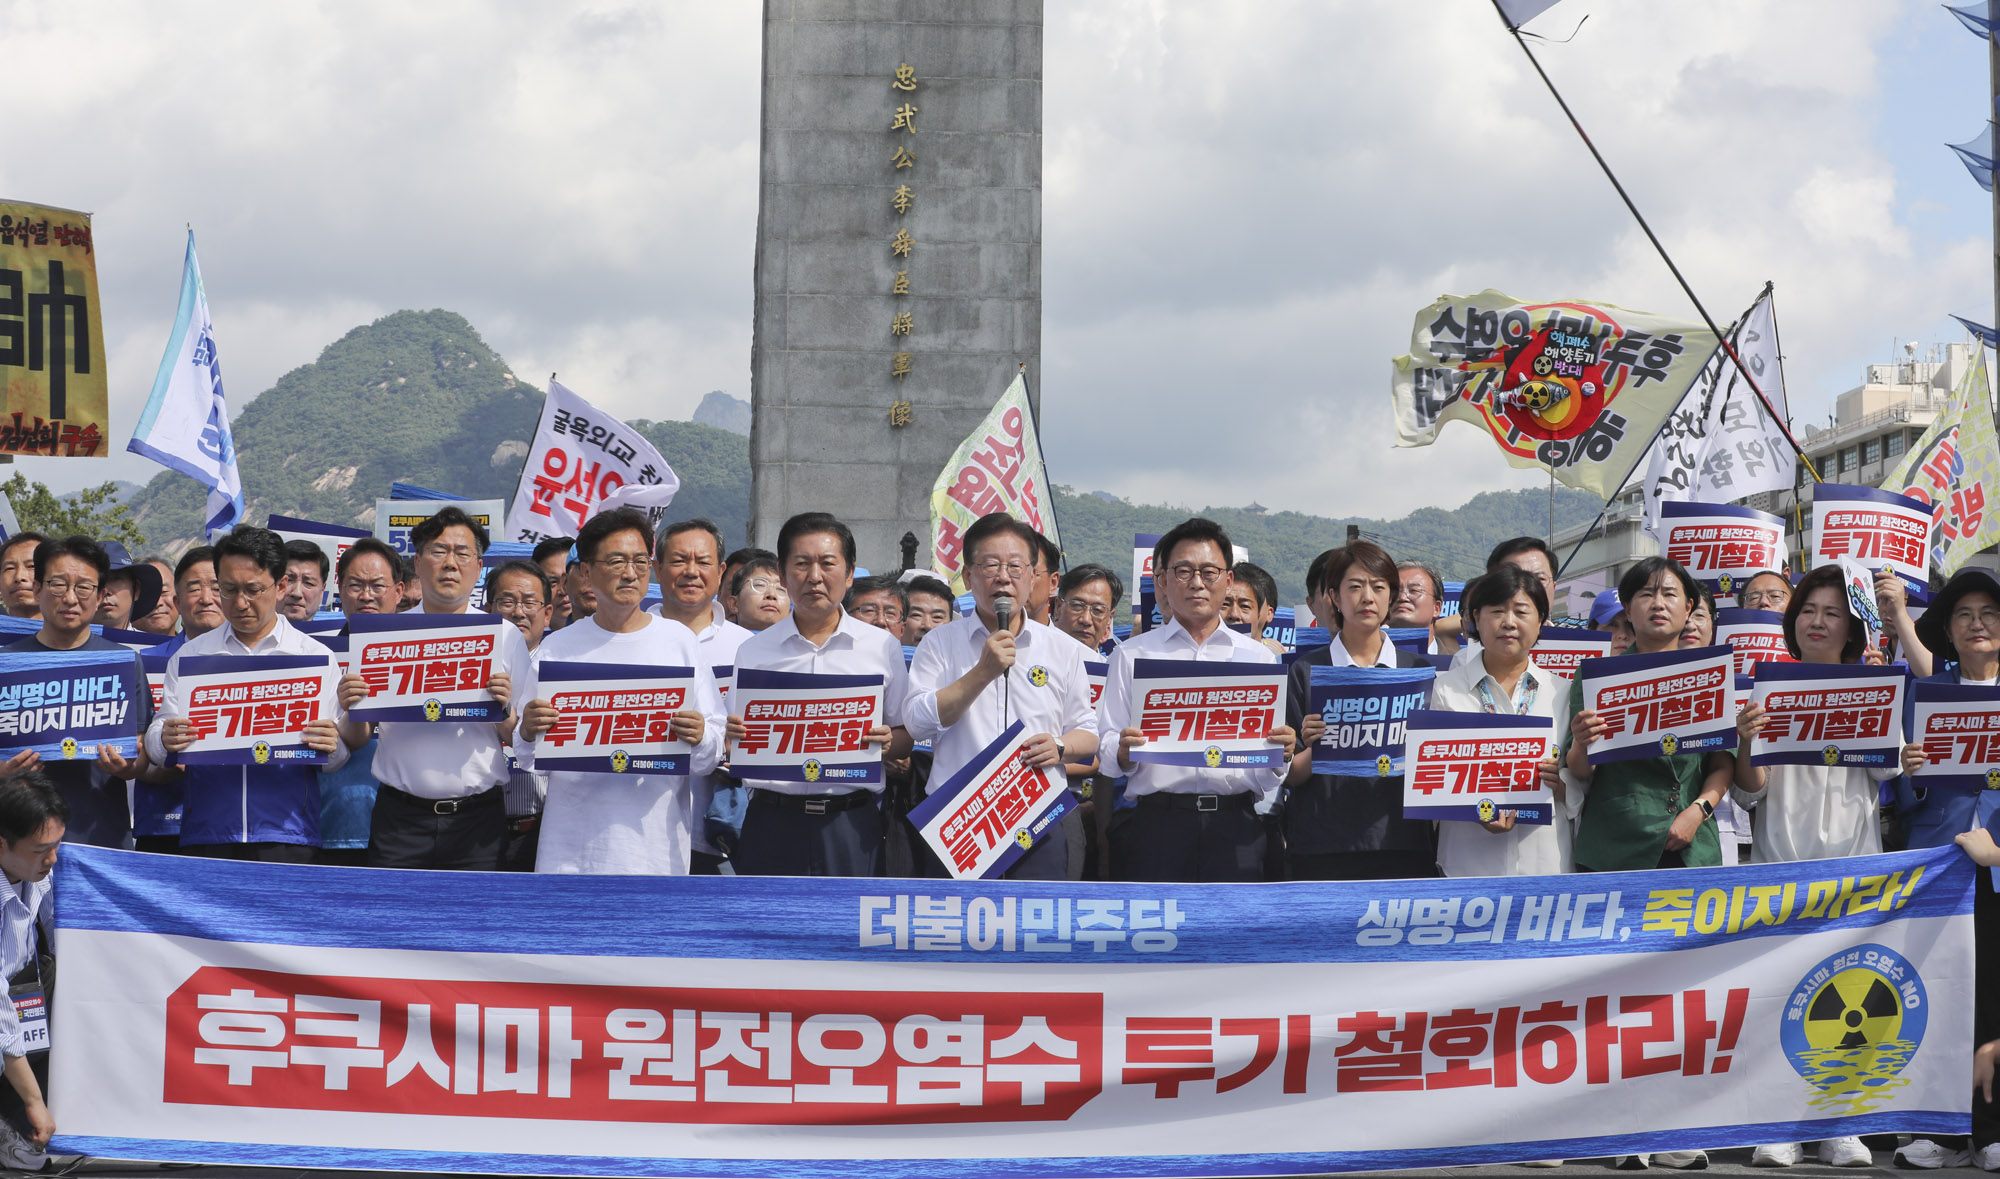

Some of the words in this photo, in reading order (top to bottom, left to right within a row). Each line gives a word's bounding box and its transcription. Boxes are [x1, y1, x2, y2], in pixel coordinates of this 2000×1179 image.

[0, 214, 48, 248] 윤석열
[54, 224, 91, 255] 탄핵
[1544, 346, 1595, 364] 해양투기
[1553, 360, 1583, 377] 반대
[60, 422, 102, 457] 구속
[553, 408, 638, 468] 굴욕외교
[1673, 528, 1717, 541] 후쿠시마
[1720, 528, 1775, 541] 원전오염수
[1828, 514, 1877, 527] 후쿠시마
[1880, 515, 1925, 536] 원전오염수
[1667, 542, 1775, 570] 투기철회
[1819, 531, 1925, 569] 투기철회
[366, 644, 420, 661] 후쿠시마
[423, 639, 490, 658] 원전오염수
[1728, 636, 1773, 648] 후쿠시마
[194, 686, 249, 704] 후쿠시마
[251, 680, 318, 699] 원전오염수
[360, 658, 493, 698] 투기철회
[1601, 684, 1655, 706] 후쿠시마
[1656, 670, 1722, 695] 원전오염수
[0, 680, 70, 711] 생명의
[73, 674, 126, 702] 바다,
[554, 694, 610, 711] 후쿠시마
[612, 692, 680, 709] 원전오염수
[1149, 690, 1203, 707] 후쿠시마
[1206, 688, 1273, 706] 원전오염수
[1768, 694, 1823, 710] 후쿠시마
[1825, 690, 1891, 707] 원전오염수
[0, 706, 67, 736] 죽이지
[71, 700, 129, 729] 마라!
[186, 699, 320, 740] 투기철회
[445, 708, 488, 717] 더불어민주당
[748, 704, 802, 718] 후쿠시마
[804, 701, 871, 717] 원전오염수
[1322, 696, 1389, 724] 생명의
[1596, 688, 1725, 740] 투기철회
[1930, 716, 1985, 731] 후쿠시마
[544, 711, 681, 747] 투기철회
[738, 719, 873, 754] 투기철회
[1140, 707, 1275, 742] 투기철회
[1320, 722, 1385, 749] 죽이지
[1758, 708, 1893, 743] 투기철회
[274, 749, 317, 759] 더불어민주당
[1422, 744, 1477, 759] 후쿠시마
[1478, 741, 1542, 757] 원전오염수
[1682, 737, 1724, 749] 더불어민주당
[632, 760, 676, 770] 더불어민주당
[1226, 754, 1269, 765] 더불어민주당
[1843, 754, 1885, 763] 더불어민주당
[825, 768, 868, 778] 더불어민주당
[1412, 760, 1544, 795] 투기철회
[942, 796, 985, 842] 후쿠시마
[949, 764, 1052, 874] 투기철회
[1355, 896, 1512, 947] 생명의
[1516, 889, 1631, 944] 바다,
[1641, 882, 1798, 937] 죽이지
[1796, 865, 1927, 921] 마라!
[859, 894, 1187, 953] 더불어민주당
[1788, 967, 1832, 1021] 후쿠시마
[1832, 951, 1861, 973] 원전
[1862, 950, 1905, 981] 오염수
[1899, 980, 1921, 1010] NO
[193, 988, 583, 1099] 후쿠시마
[602, 1008, 1082, 1106] 원전오염수
[1121, 1014, 1312, 1100] 투기
[1333, 987, 1750, 1094] 철회하라!
